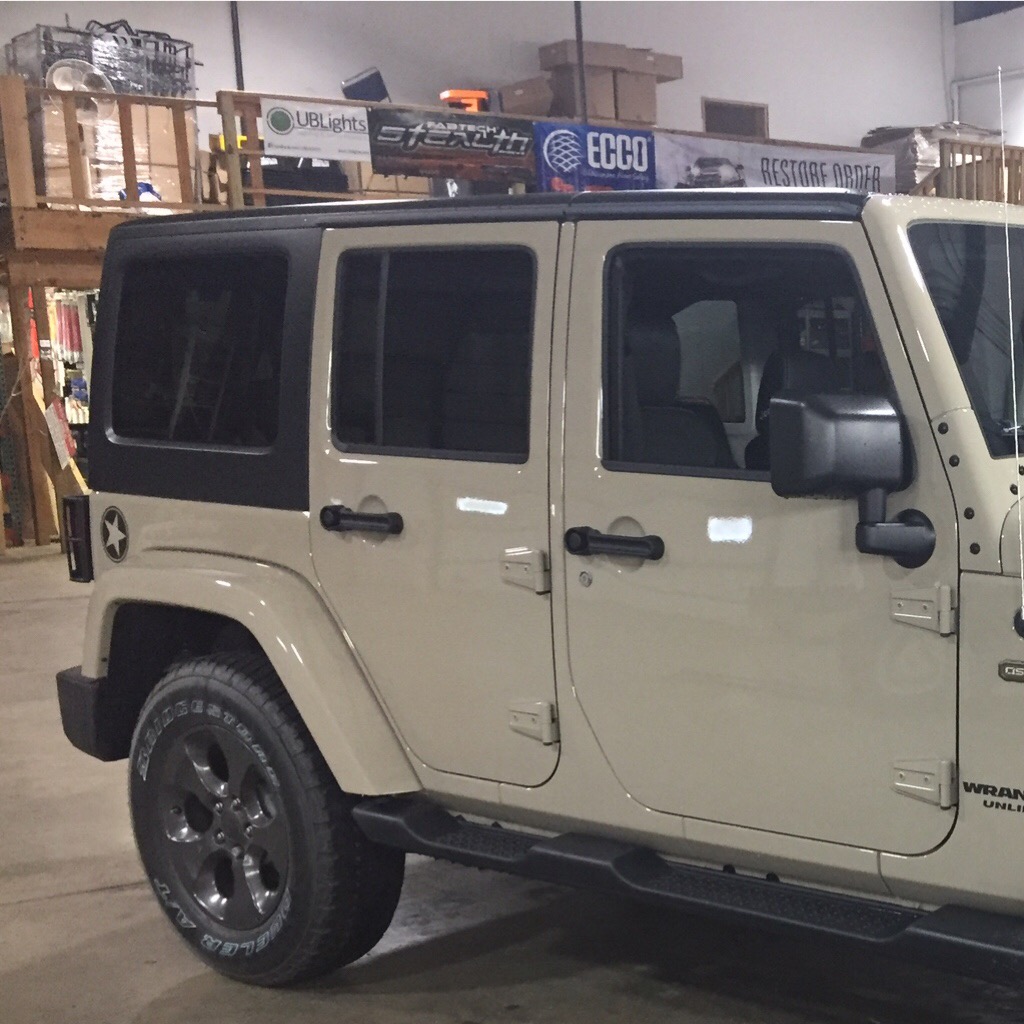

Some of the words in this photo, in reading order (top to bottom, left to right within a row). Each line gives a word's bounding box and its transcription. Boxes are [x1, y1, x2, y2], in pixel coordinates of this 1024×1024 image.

[296, 110, 367, 134] UBLights
[586, 131, 649, 173] ECCO
[760, 157, 828, 188] RESTORE
[832, 162, 881, 193] ORDER
